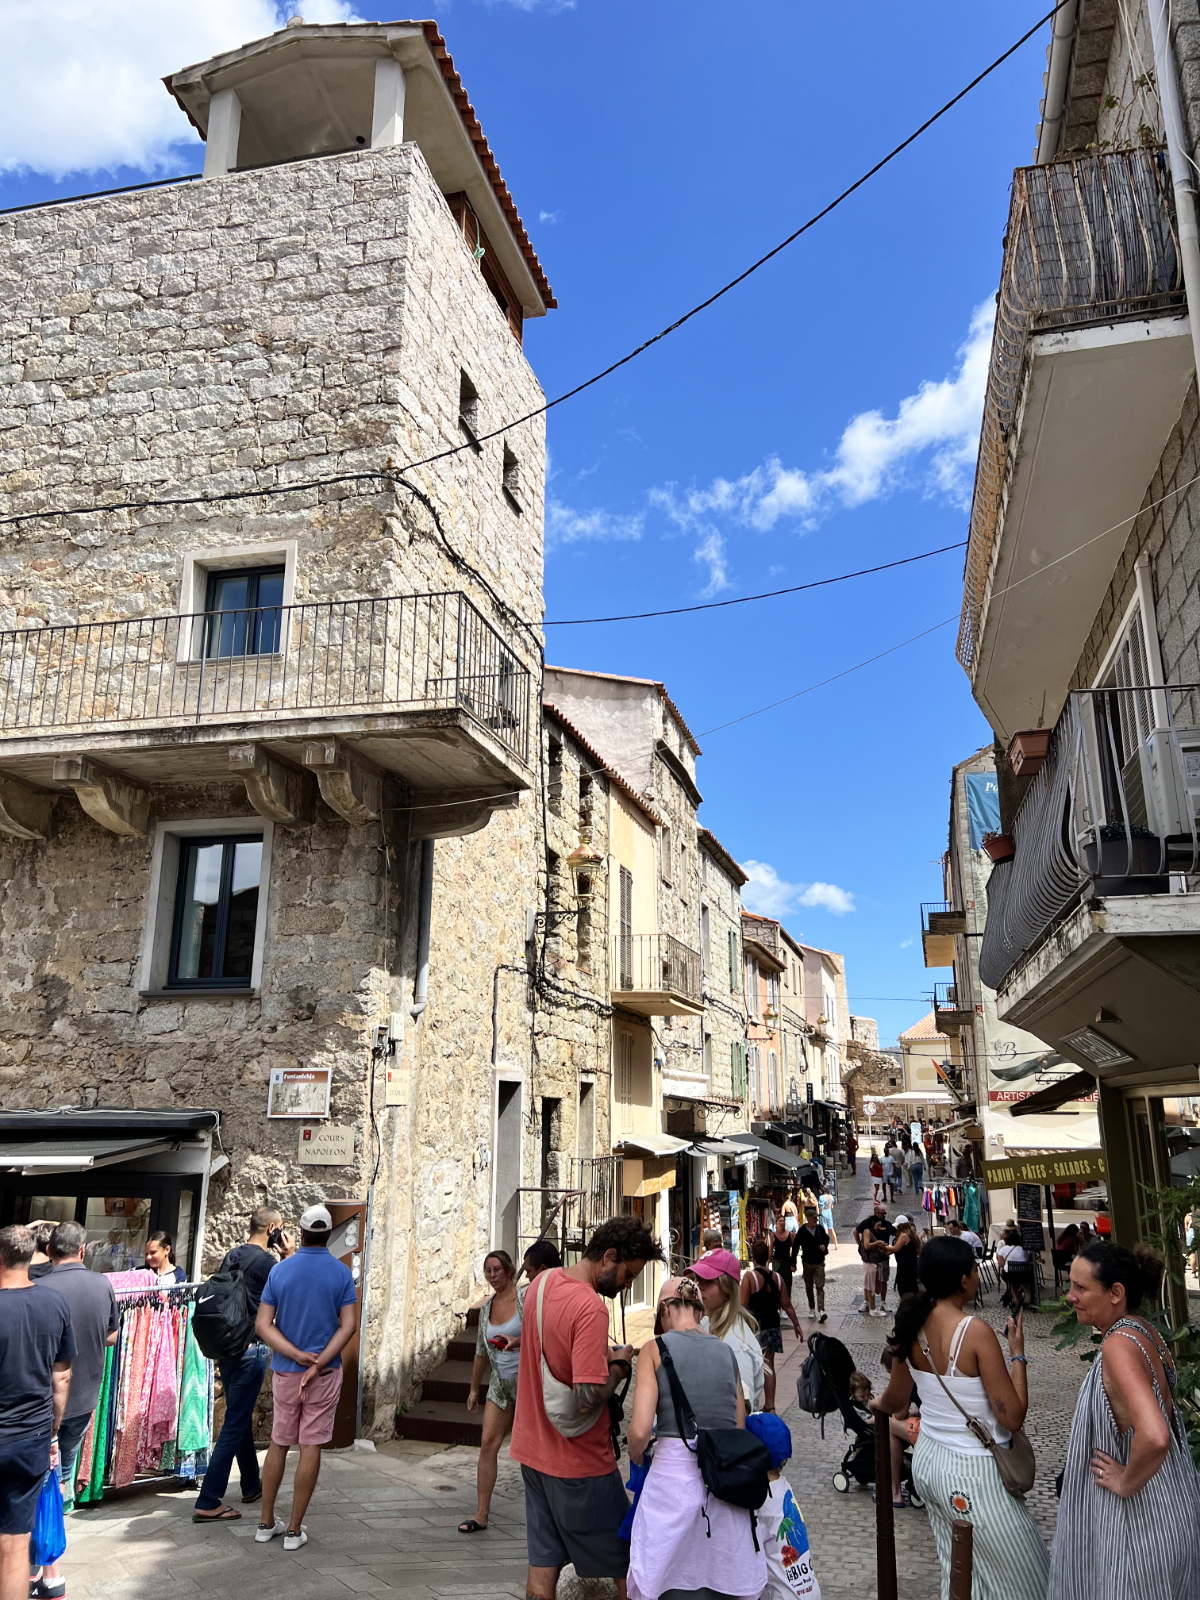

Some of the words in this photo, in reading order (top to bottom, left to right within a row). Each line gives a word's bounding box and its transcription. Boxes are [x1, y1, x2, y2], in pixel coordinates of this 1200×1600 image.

[996, 1091, 1036, 1101] ARTISA
[987, 1167, 1015, 1183] PANINI
[1022, 1163, 1047, 1180] PÂTES
[1053, 1160, 1091, 1177] SALADES
[790, 1562, 809, 1580] BIG
